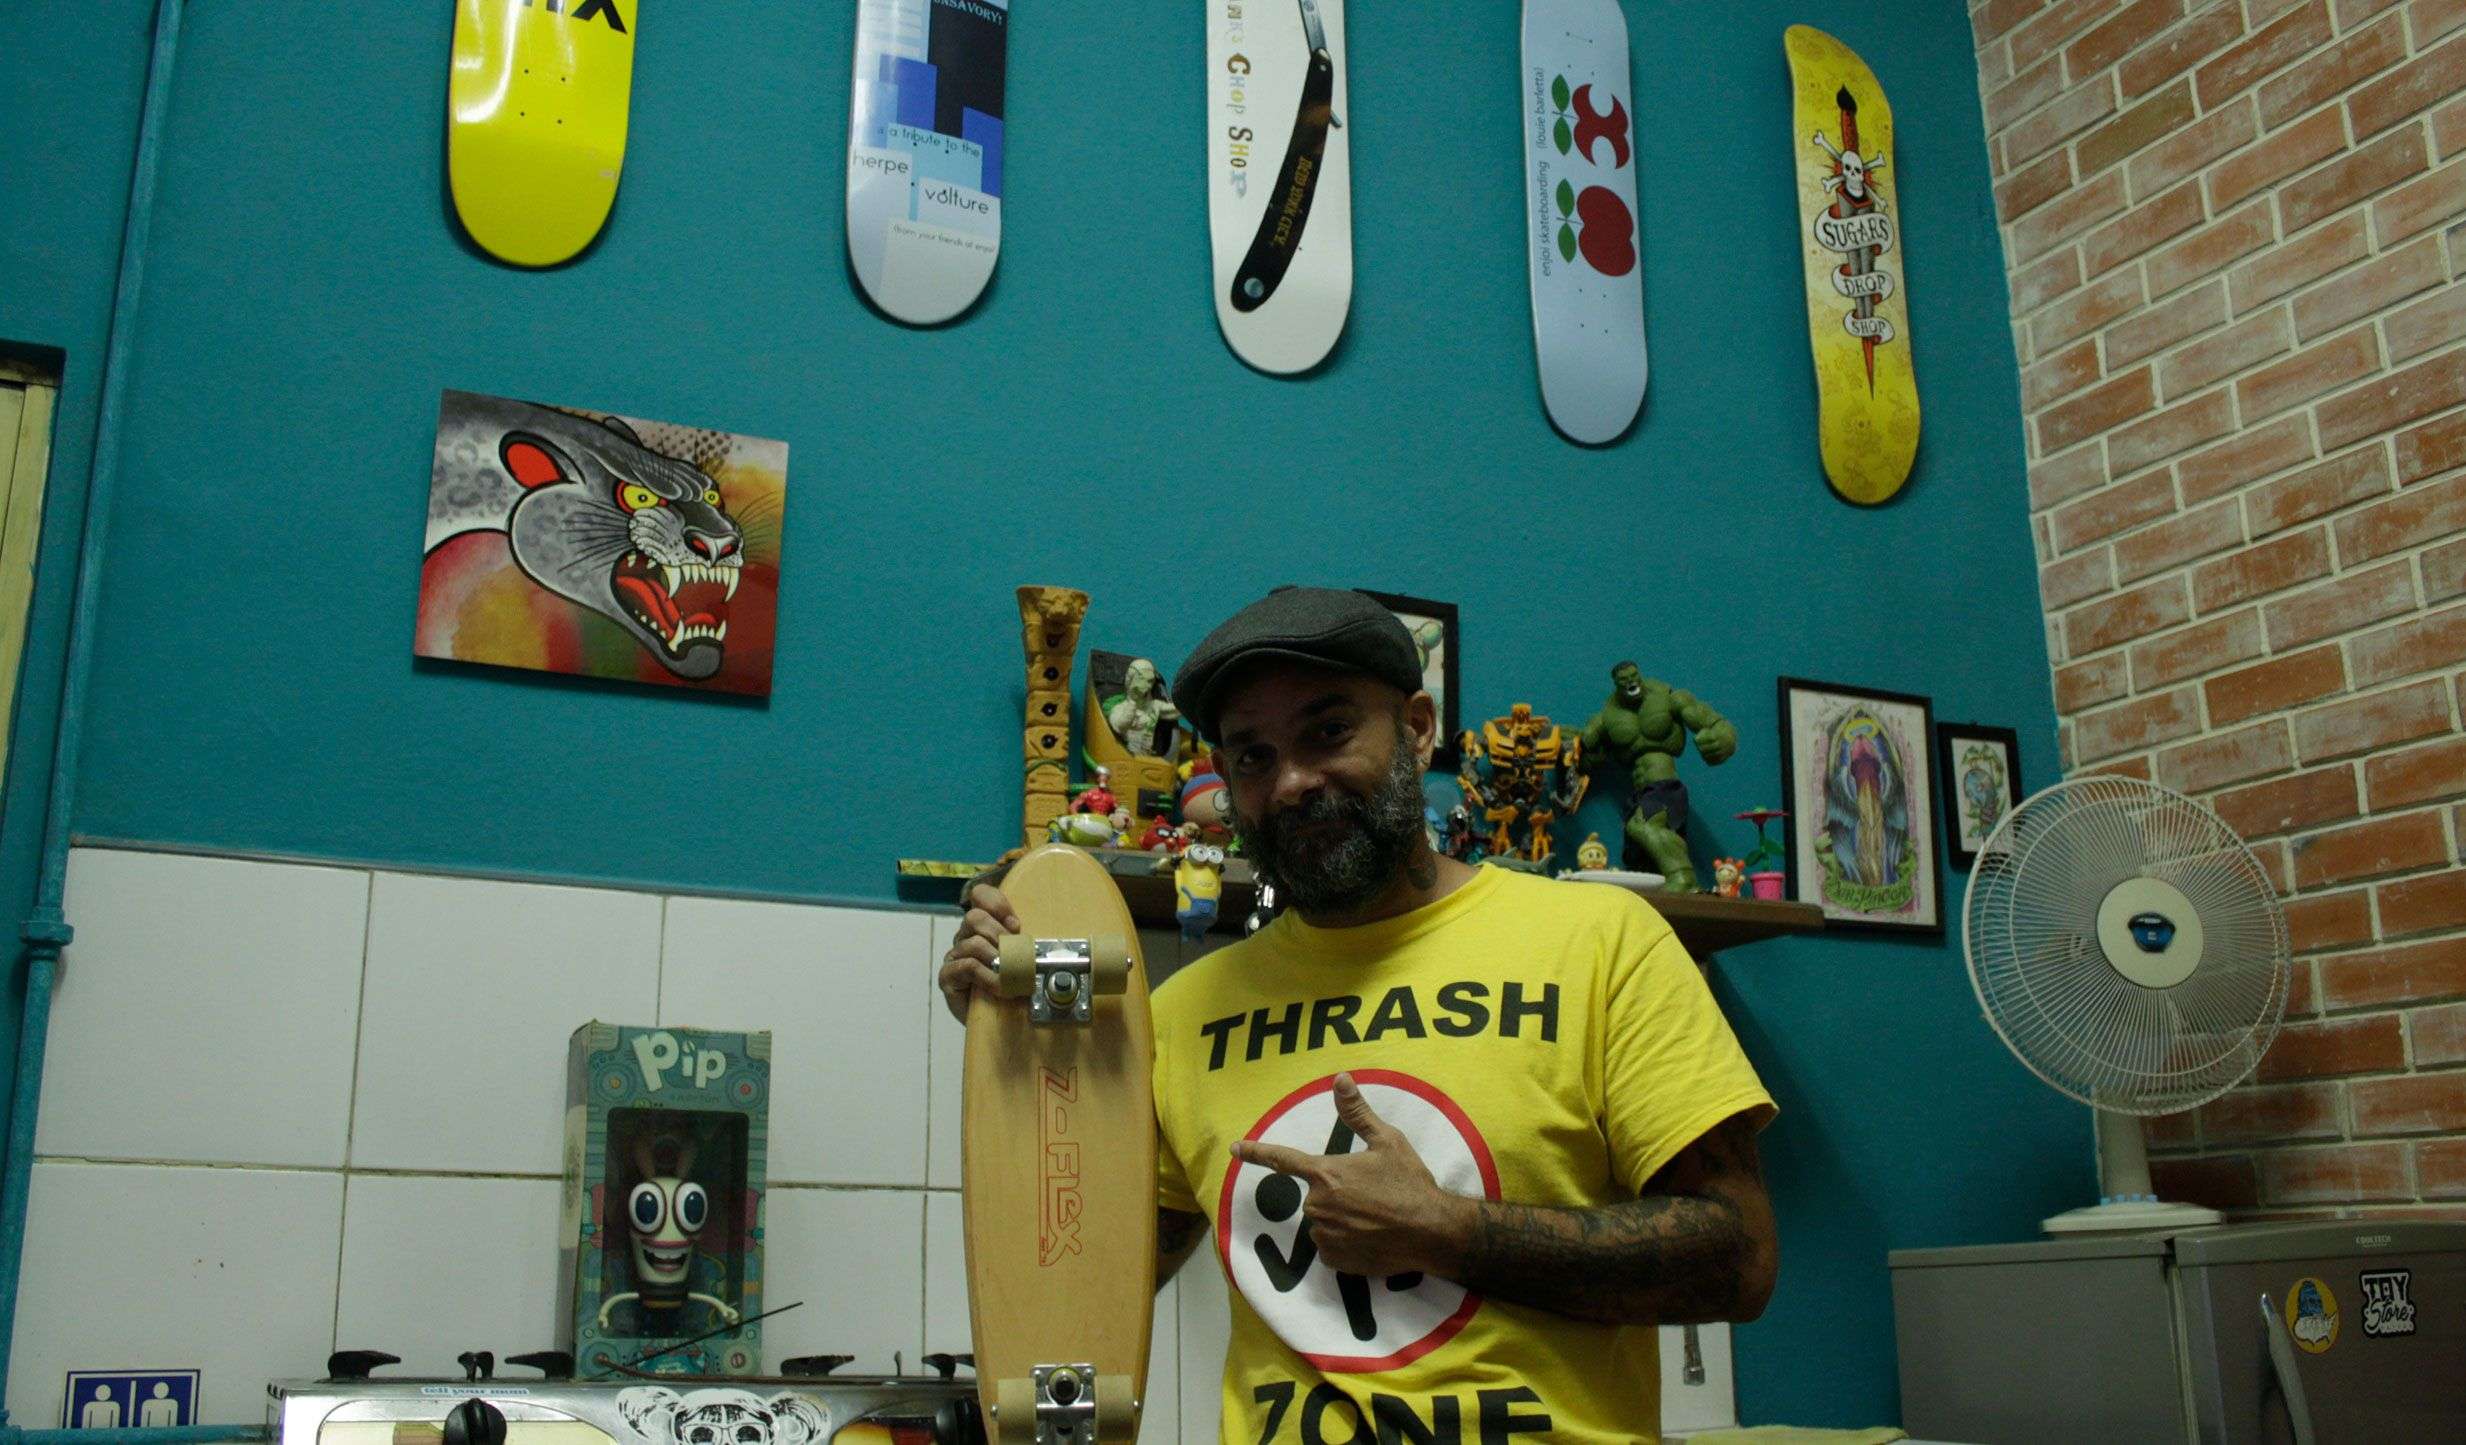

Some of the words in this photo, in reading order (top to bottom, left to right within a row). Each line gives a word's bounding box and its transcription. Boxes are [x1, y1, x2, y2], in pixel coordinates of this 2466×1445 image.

[902, 128, 941, 146] tribute
[962, 141, 981, 158] the
[852, 149, 909, 175] herpe
[1537, 160, 1551, 245] skateboarding
[1822, 217, 1889, 247] SUGARS
[1842, 274, 1886, 296] DROP
[1851, 321, 1886, 335] SHOP
[1200, 980, 1560, 1072] THRASH
[630, 1030, 727, 1092] Pip
[2362, 1275, 2408, 1302] TOY
[1253, 1380, 1552, 1445] ZONE
